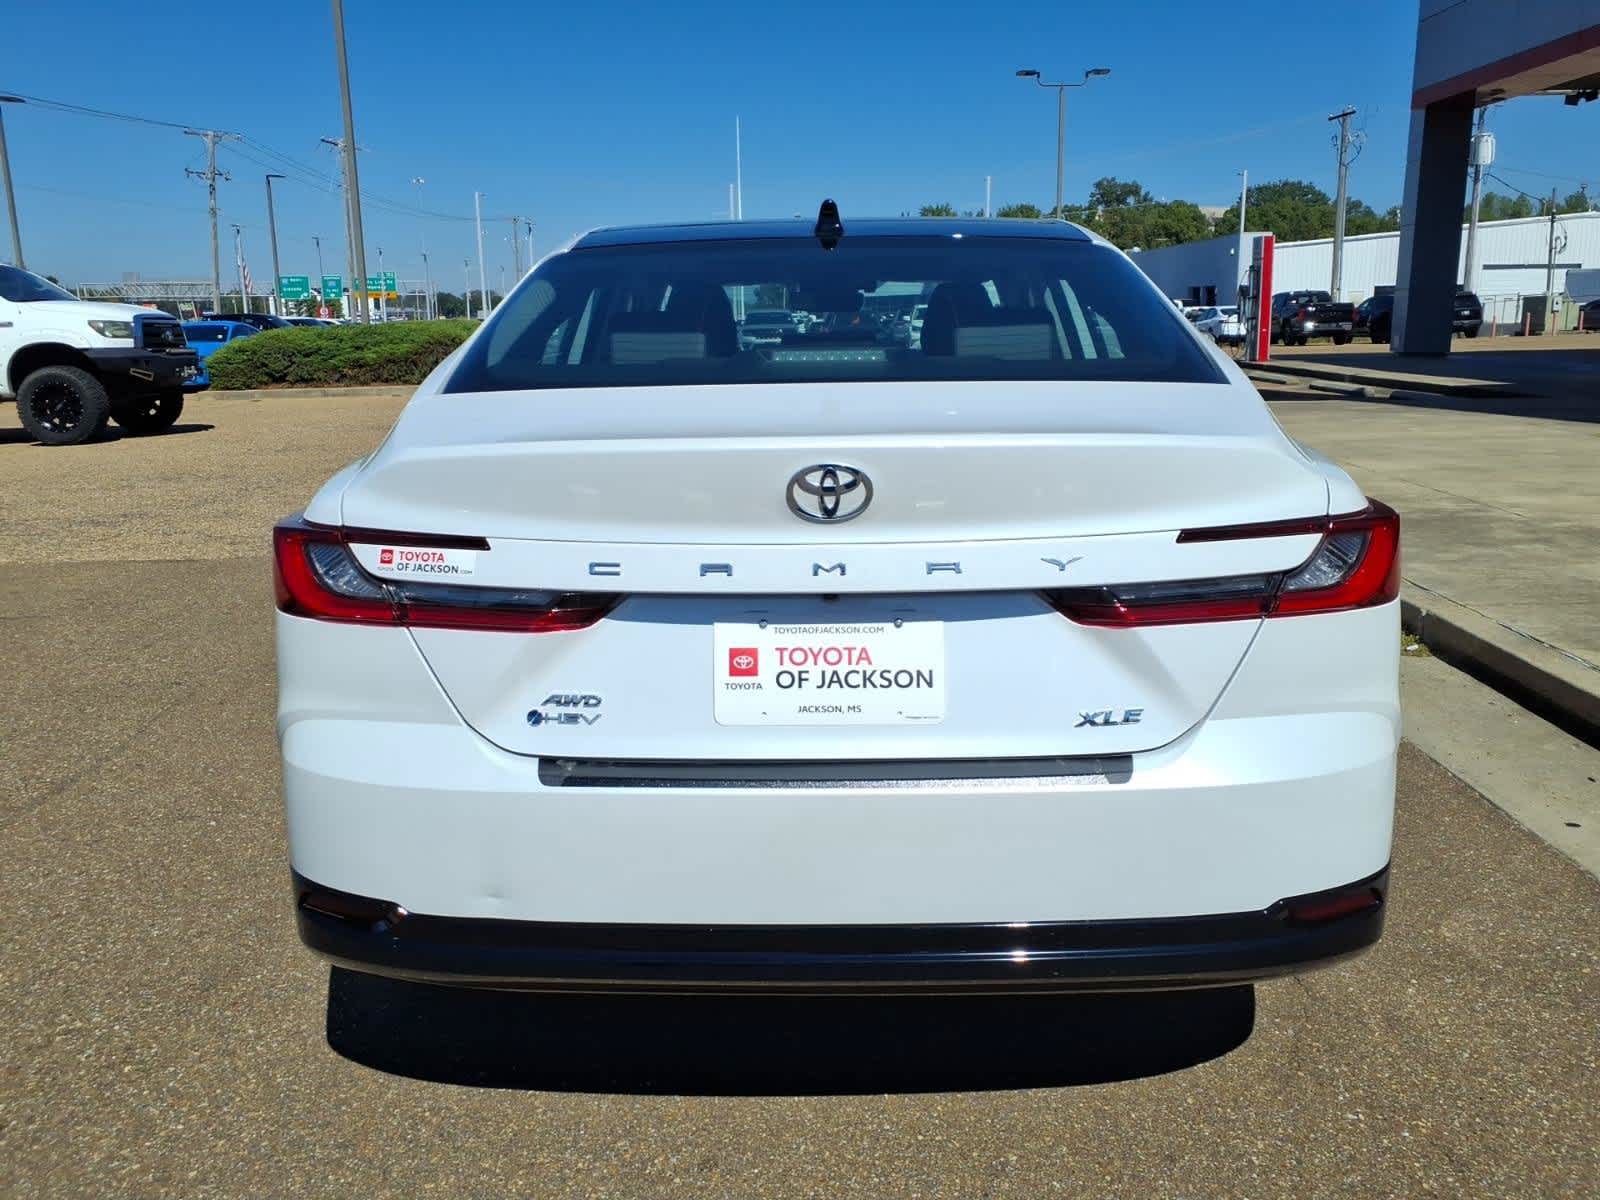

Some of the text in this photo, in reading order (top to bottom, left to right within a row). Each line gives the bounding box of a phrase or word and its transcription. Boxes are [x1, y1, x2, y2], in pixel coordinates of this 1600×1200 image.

[399, 551, 445, 563] TOYOTA
[396, 563, 409, 572] OF
[588, 556, 1084, 577] CAMRY
[774, 626, 885, 635] TOYOTAOFJACKSON.COM
[775, 647, 873, 666] TOYOTA
[775, 669, 934, 689] OF JACKSON
[725, 682, 763, 690] TOYOTA
[541, 694, 602, 707] AWD
[798, 705, 862, 714] JACKSON, MS
[1074, 708, 1145, 728] XLE
